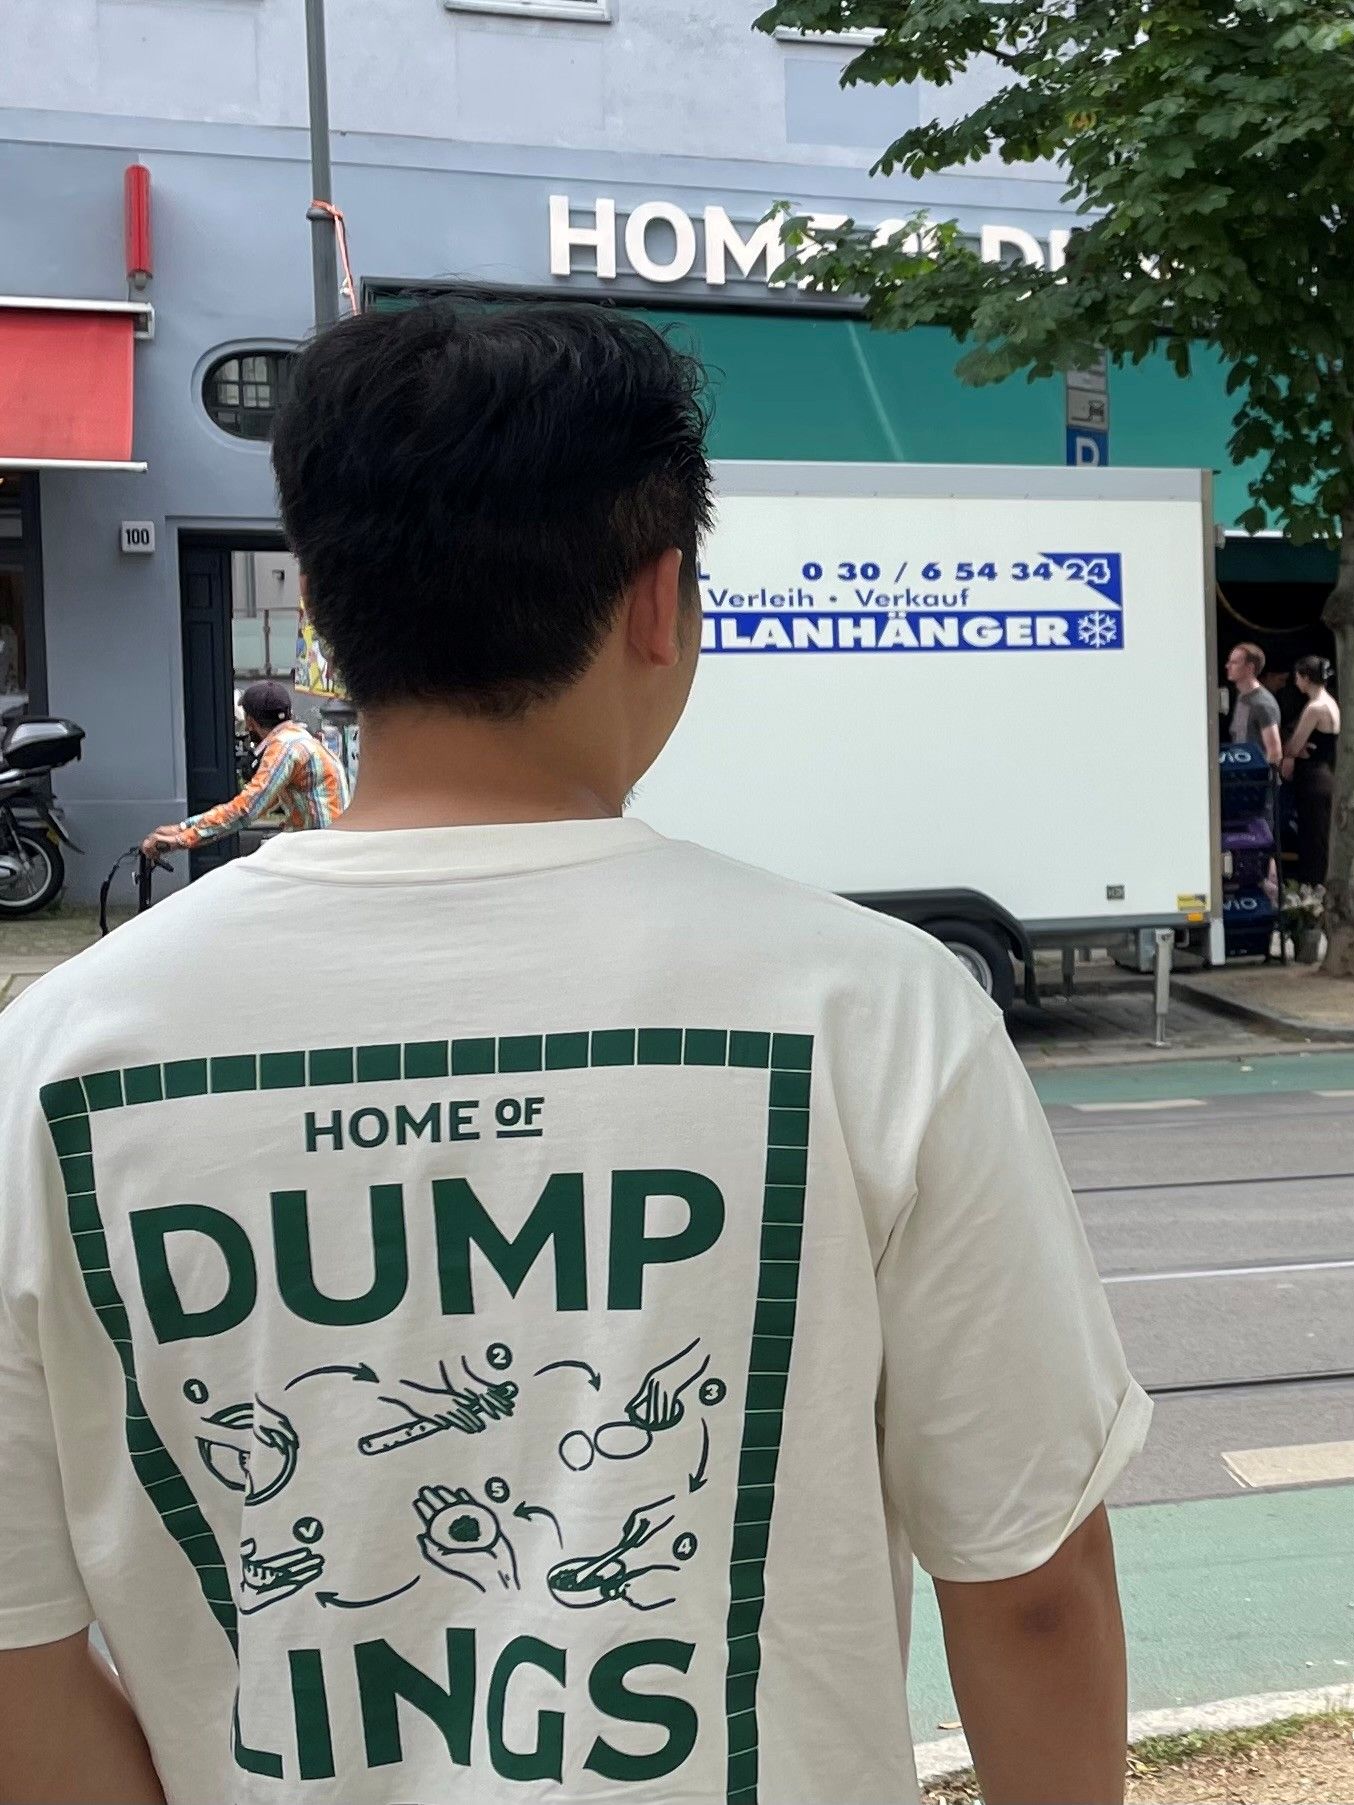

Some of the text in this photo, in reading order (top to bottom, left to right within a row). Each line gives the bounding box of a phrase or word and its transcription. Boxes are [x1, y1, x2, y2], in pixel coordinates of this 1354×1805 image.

[126, 528, 150, 545] 100
[802, 562, 823, 581] 0
[837, 562, 881, 581] 30
[921, 562, 942, 581] 6
[955, 562, 998, 581] 54
[1011, 562, 1052, 581] 34
[1066, 561, 1108, 581] 24
[708, 588, 969, 607] Verleih Verkauf
[304, 1096, 545, 1152] HOME OF
[129, 1168, 726, 1344] DUMP
[493, 1348, 506, 1363] 2
[190, 1384, 202, 1399] 1
[705, 1384, 719, 1400] 3
[492, 1482, 505, 1497] 5
[677, 1538, 691, 1554] 4
